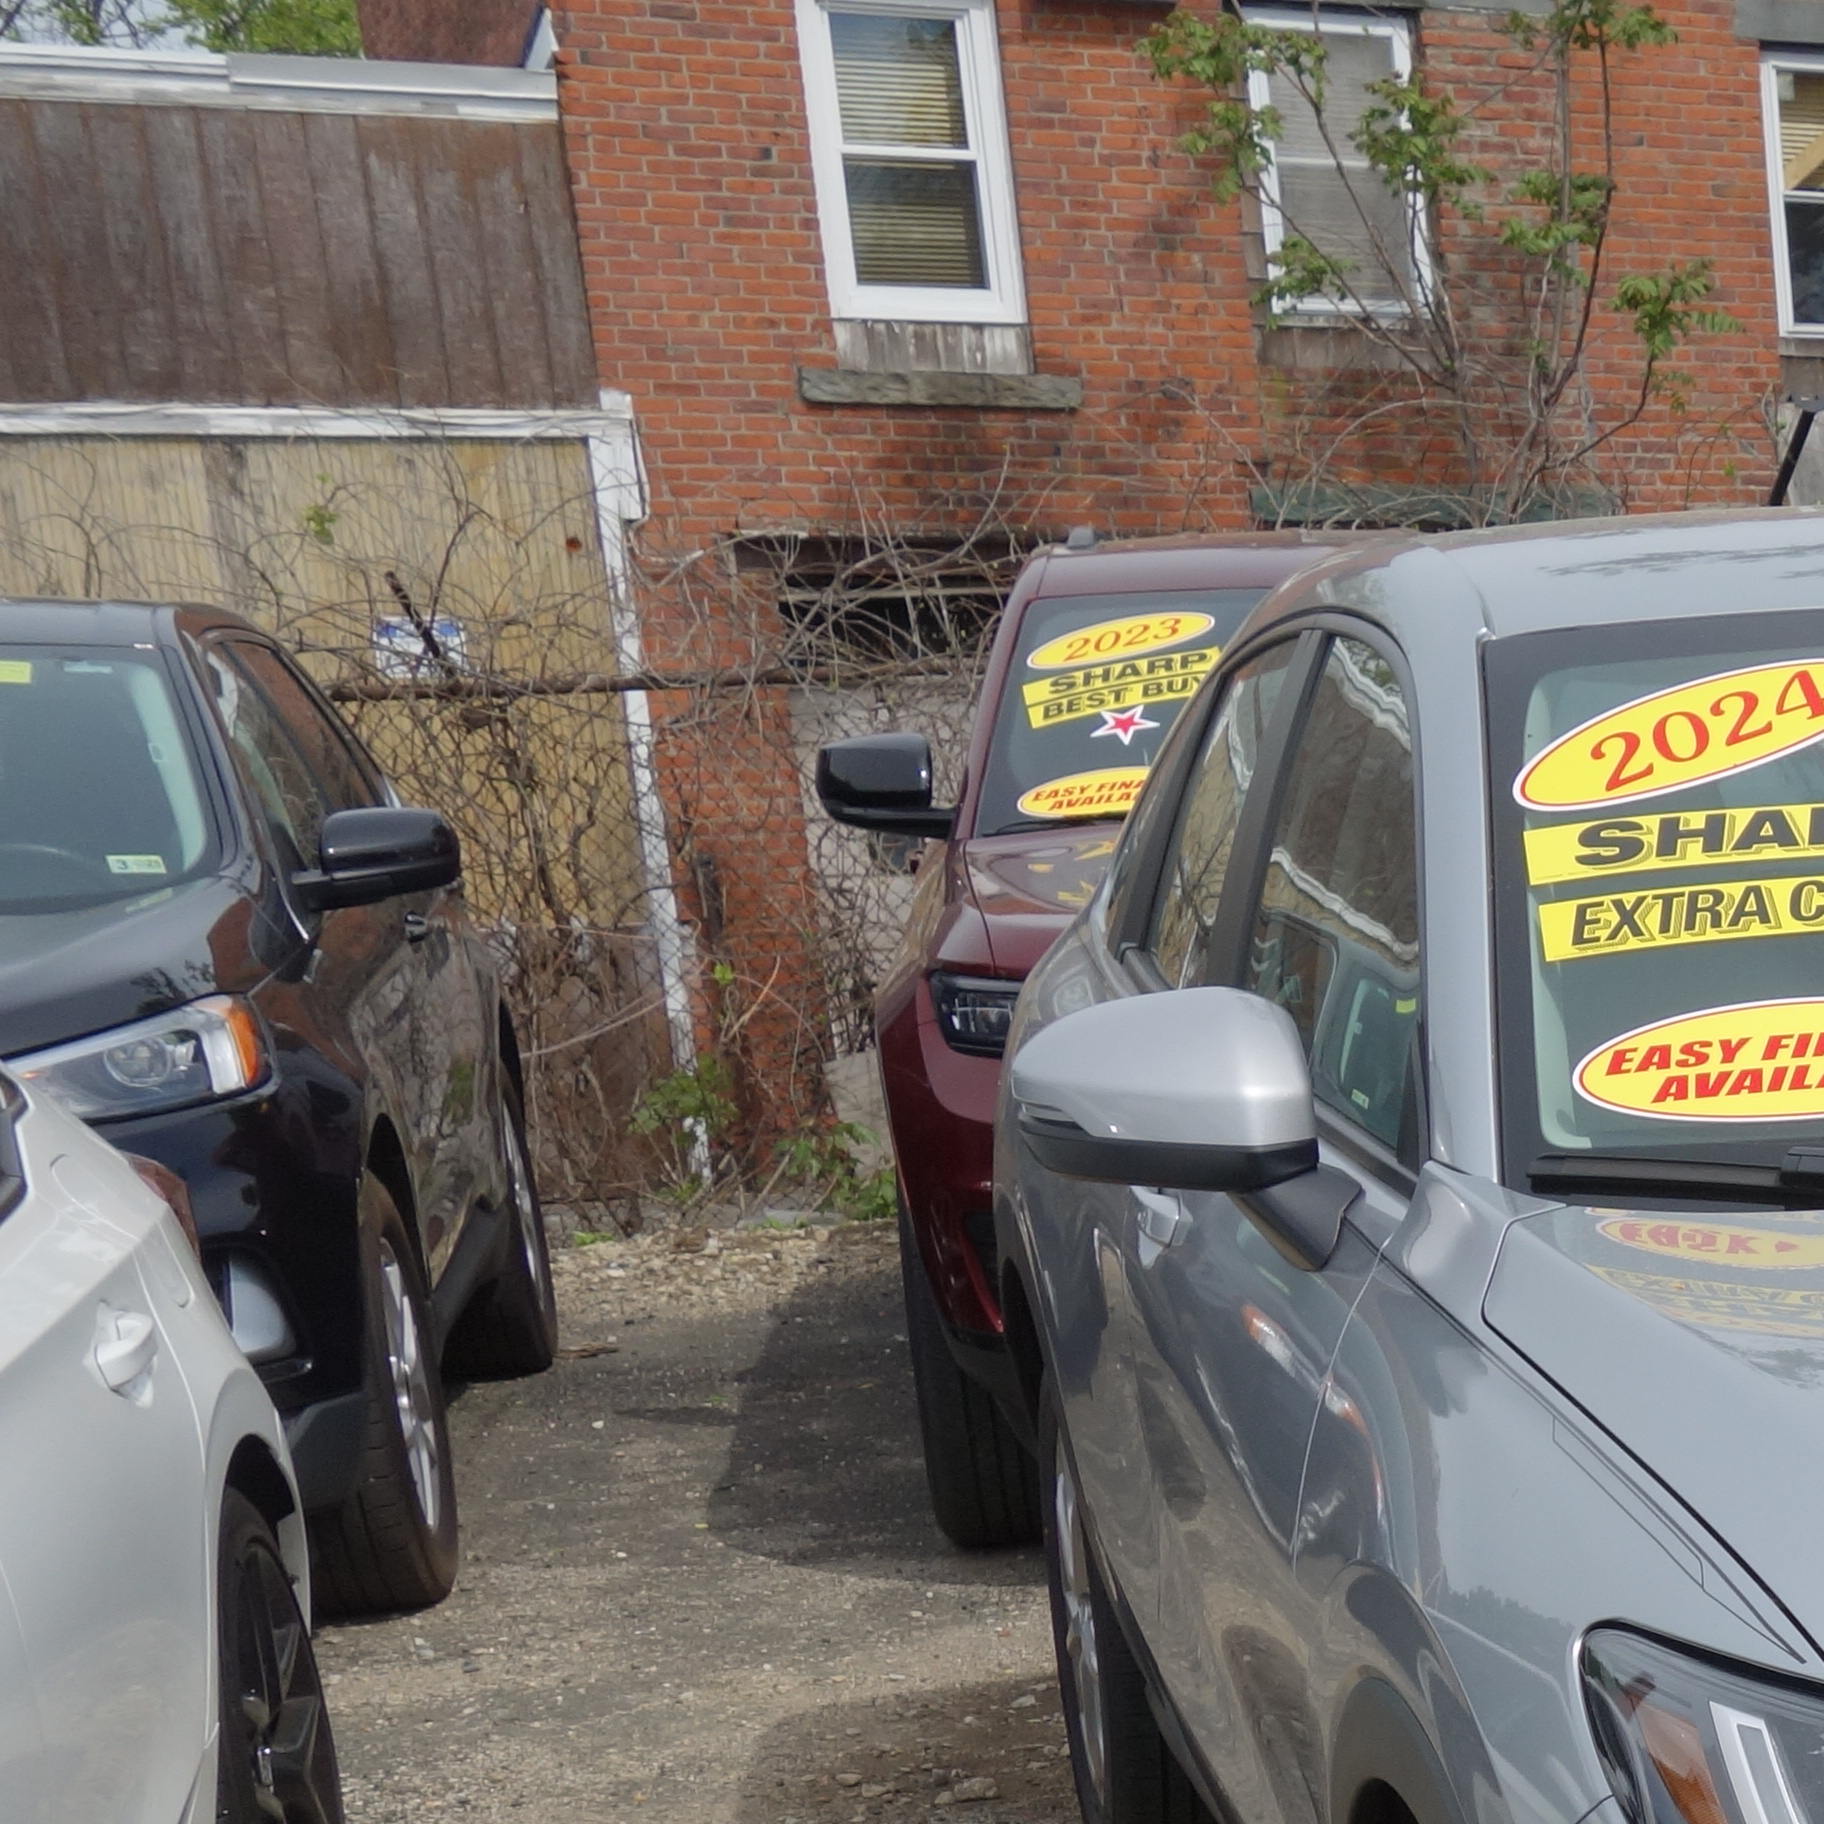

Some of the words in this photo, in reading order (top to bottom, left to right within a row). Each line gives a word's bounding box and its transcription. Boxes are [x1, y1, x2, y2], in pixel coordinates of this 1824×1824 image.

[1063, 617, 1183, 662] 2023
[1049, 652, 1210, 695] SHARP
[1042, 687, 1130, 721] BEST
[1031, 783, 1093, 802] EASY
[1095, 779, 1146, 793] FINA
[1047, 790, 1138, 812] AVAILA
[1569, 883, 1779, 952] EXTRA
[1604, 1036, 1754, 1076] EASY
